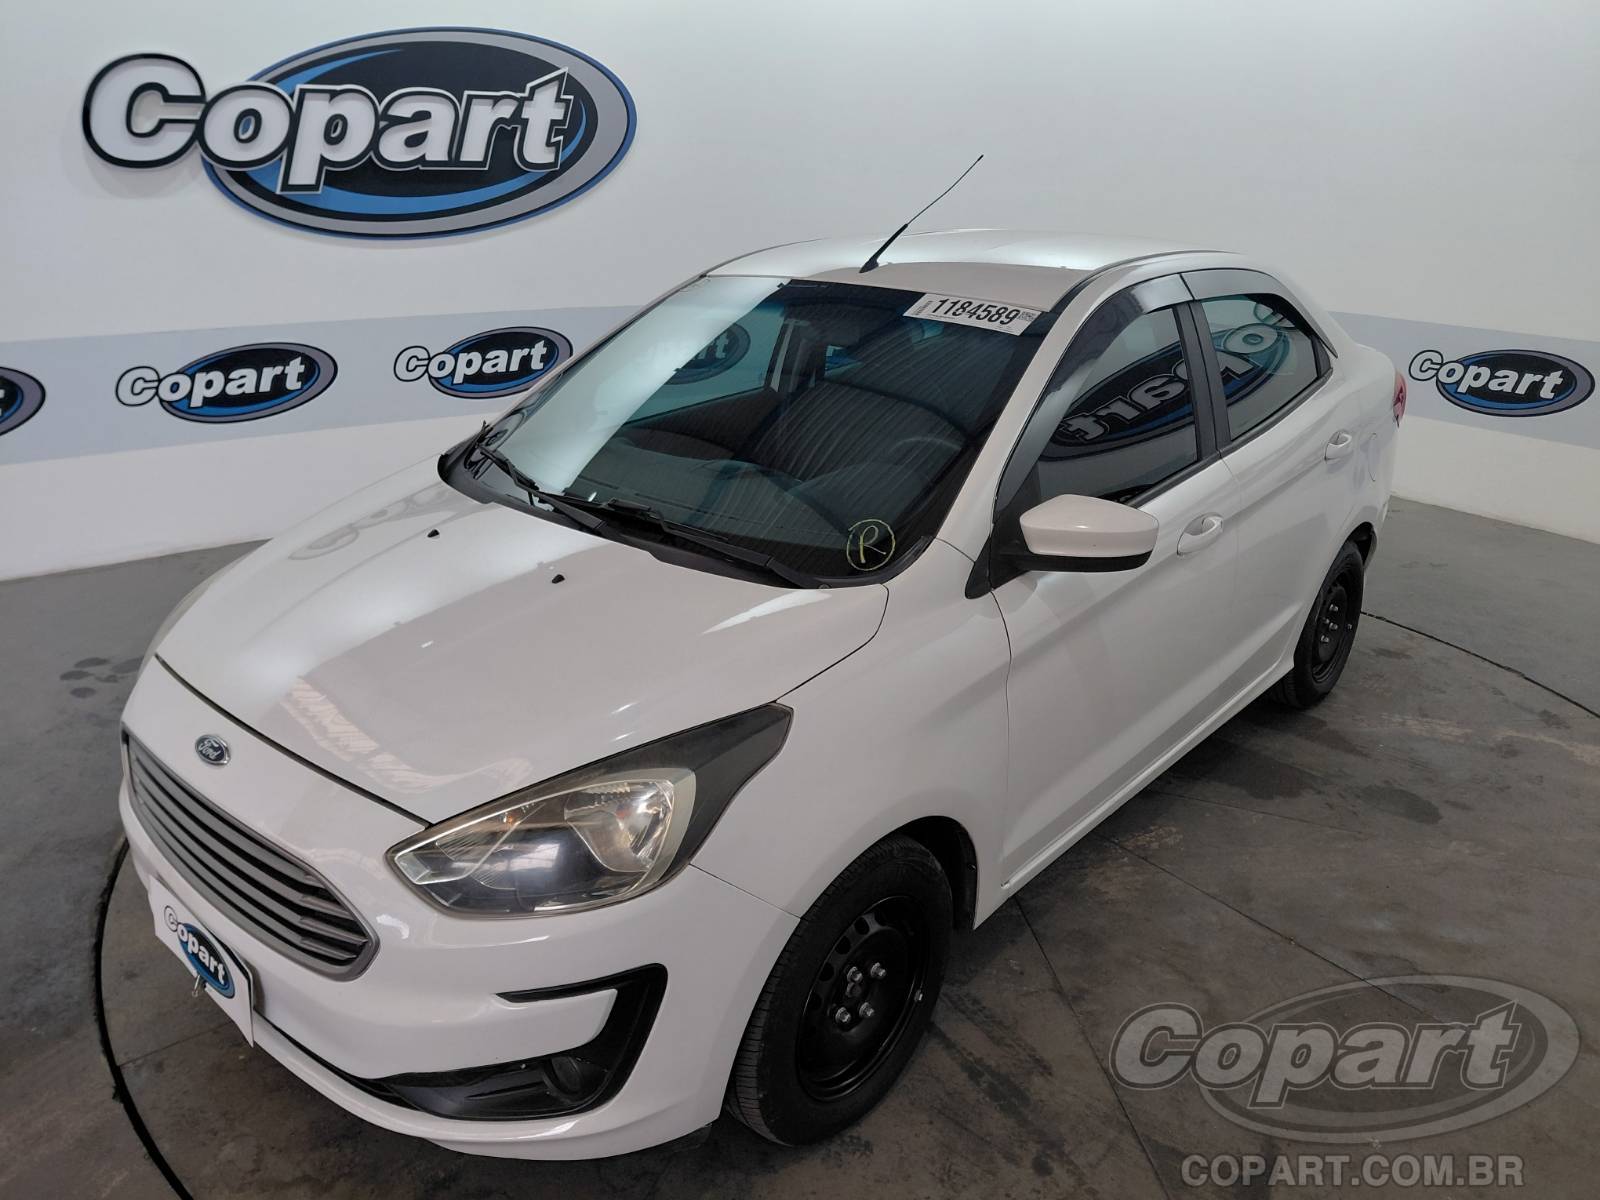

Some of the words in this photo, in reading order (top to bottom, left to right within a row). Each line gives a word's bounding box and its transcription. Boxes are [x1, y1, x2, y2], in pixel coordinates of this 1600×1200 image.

[83, 53, 573, 193] Copart
[932, 298, 1021, 326] 1184589
[115, 356, 305, 408] Copart
[394, 339, 549, 385] Copart
[1408, 349, 1565, 400] Copart
[198, 738, 222, 760] Ford
[163, 905, 226, 985] Copart
